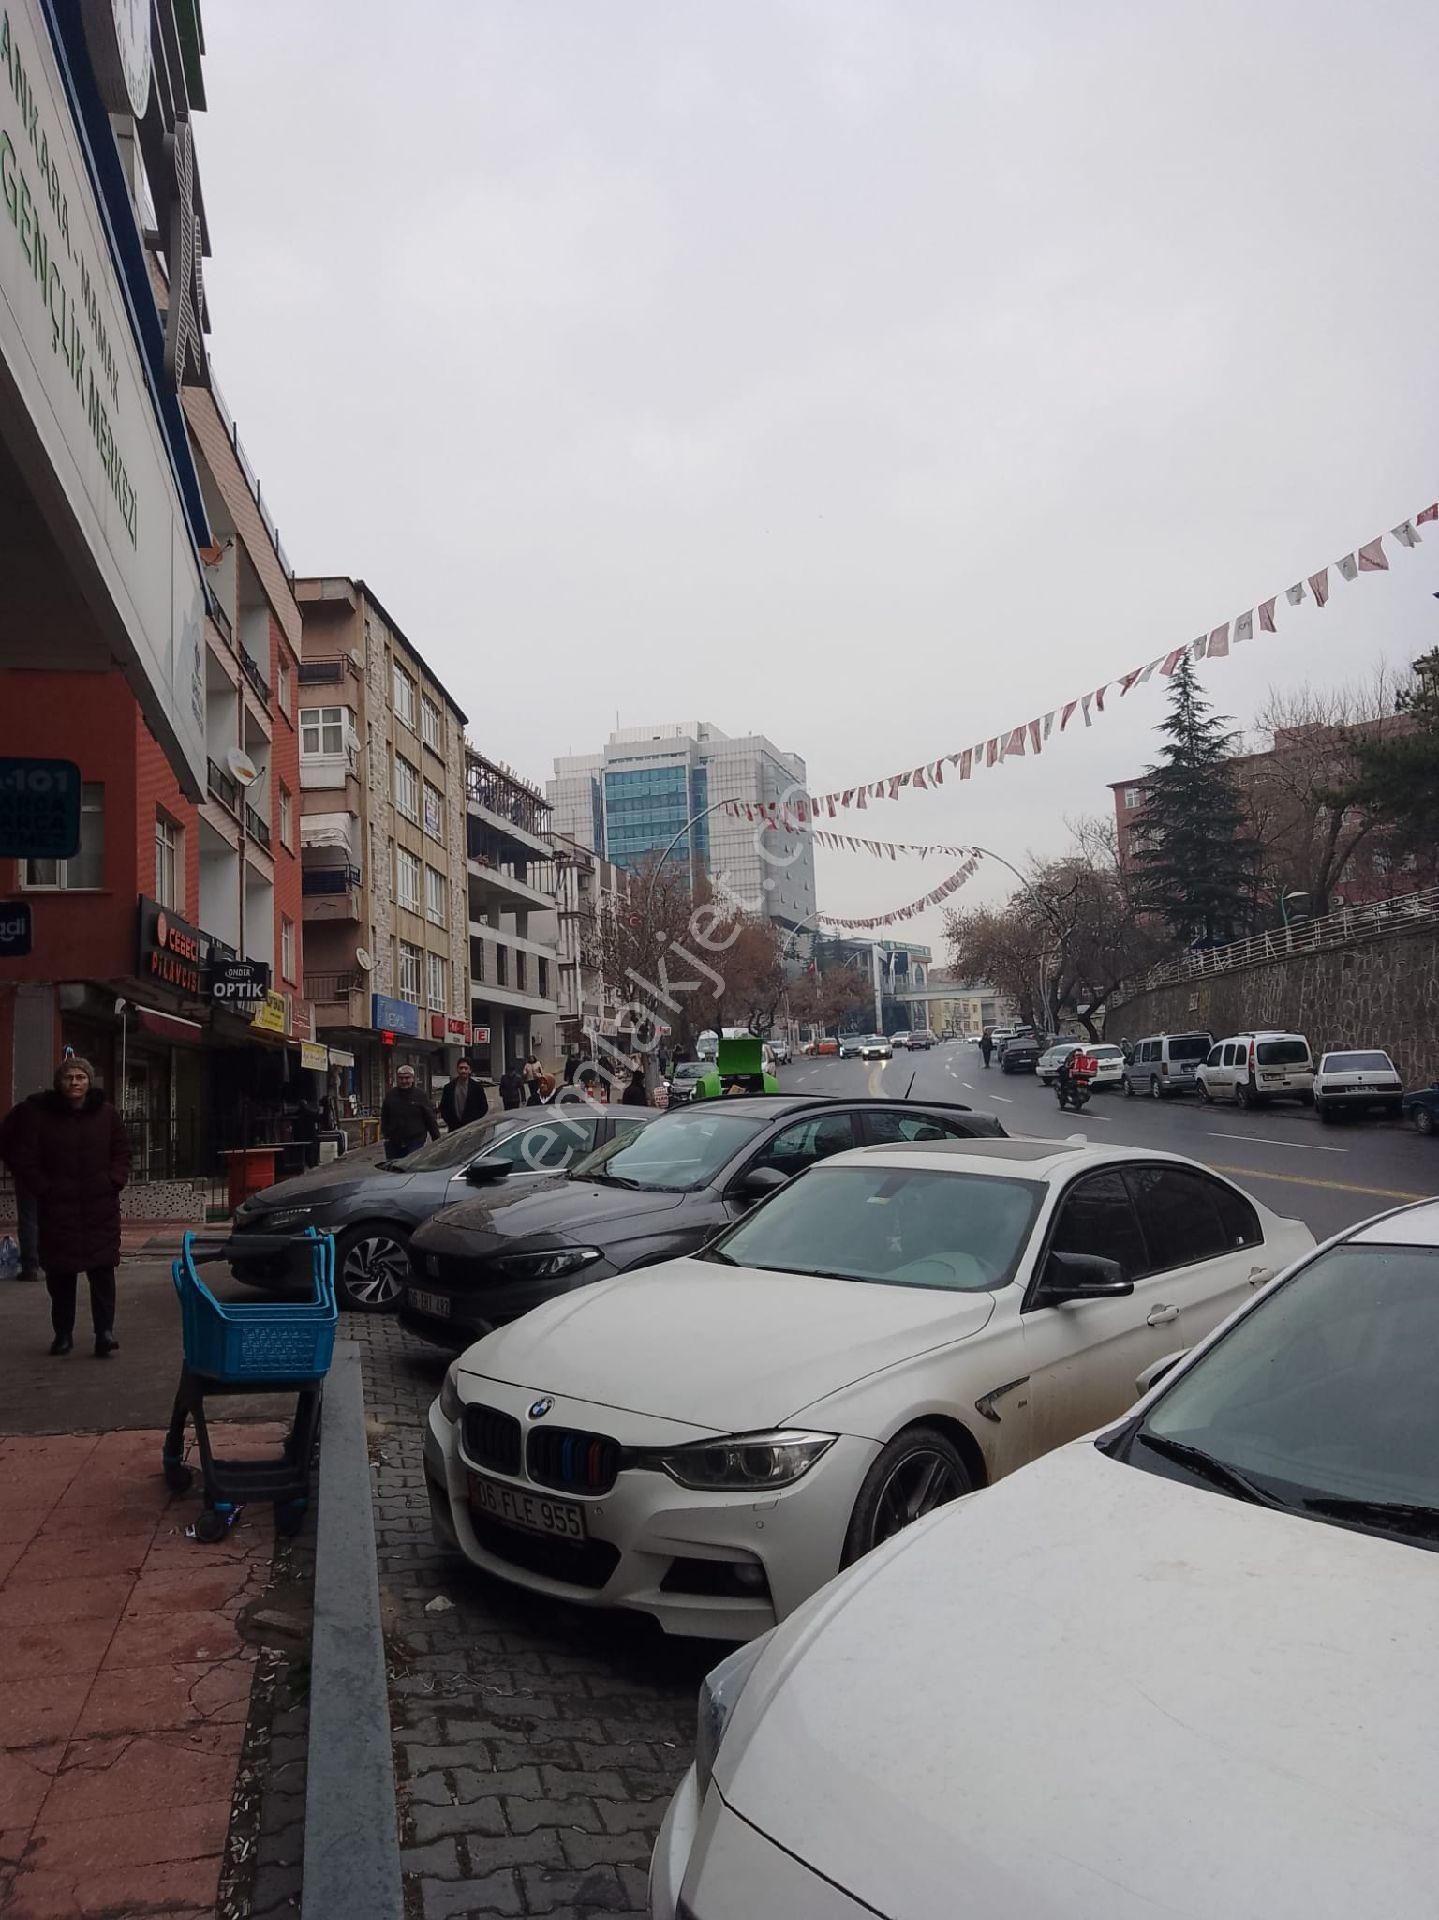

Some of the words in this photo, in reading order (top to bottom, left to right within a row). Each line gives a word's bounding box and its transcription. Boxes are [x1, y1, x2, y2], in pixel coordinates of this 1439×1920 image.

[0, 9, 70, 258] ANKARA
[81, 250, 119, 415] MAMAK
[0, 129, 85, 410] GENÇLİK
[89, 366, 137, 552] MERKEZİ
[169, 927, 197, 961] CEBEC
[213, 979, 263, 998] OPTİK
[480, 1481, 497, 1510] 06
[502, 1491, 537, 1525] FLE
[541, 1502, 580, 1537] 955
